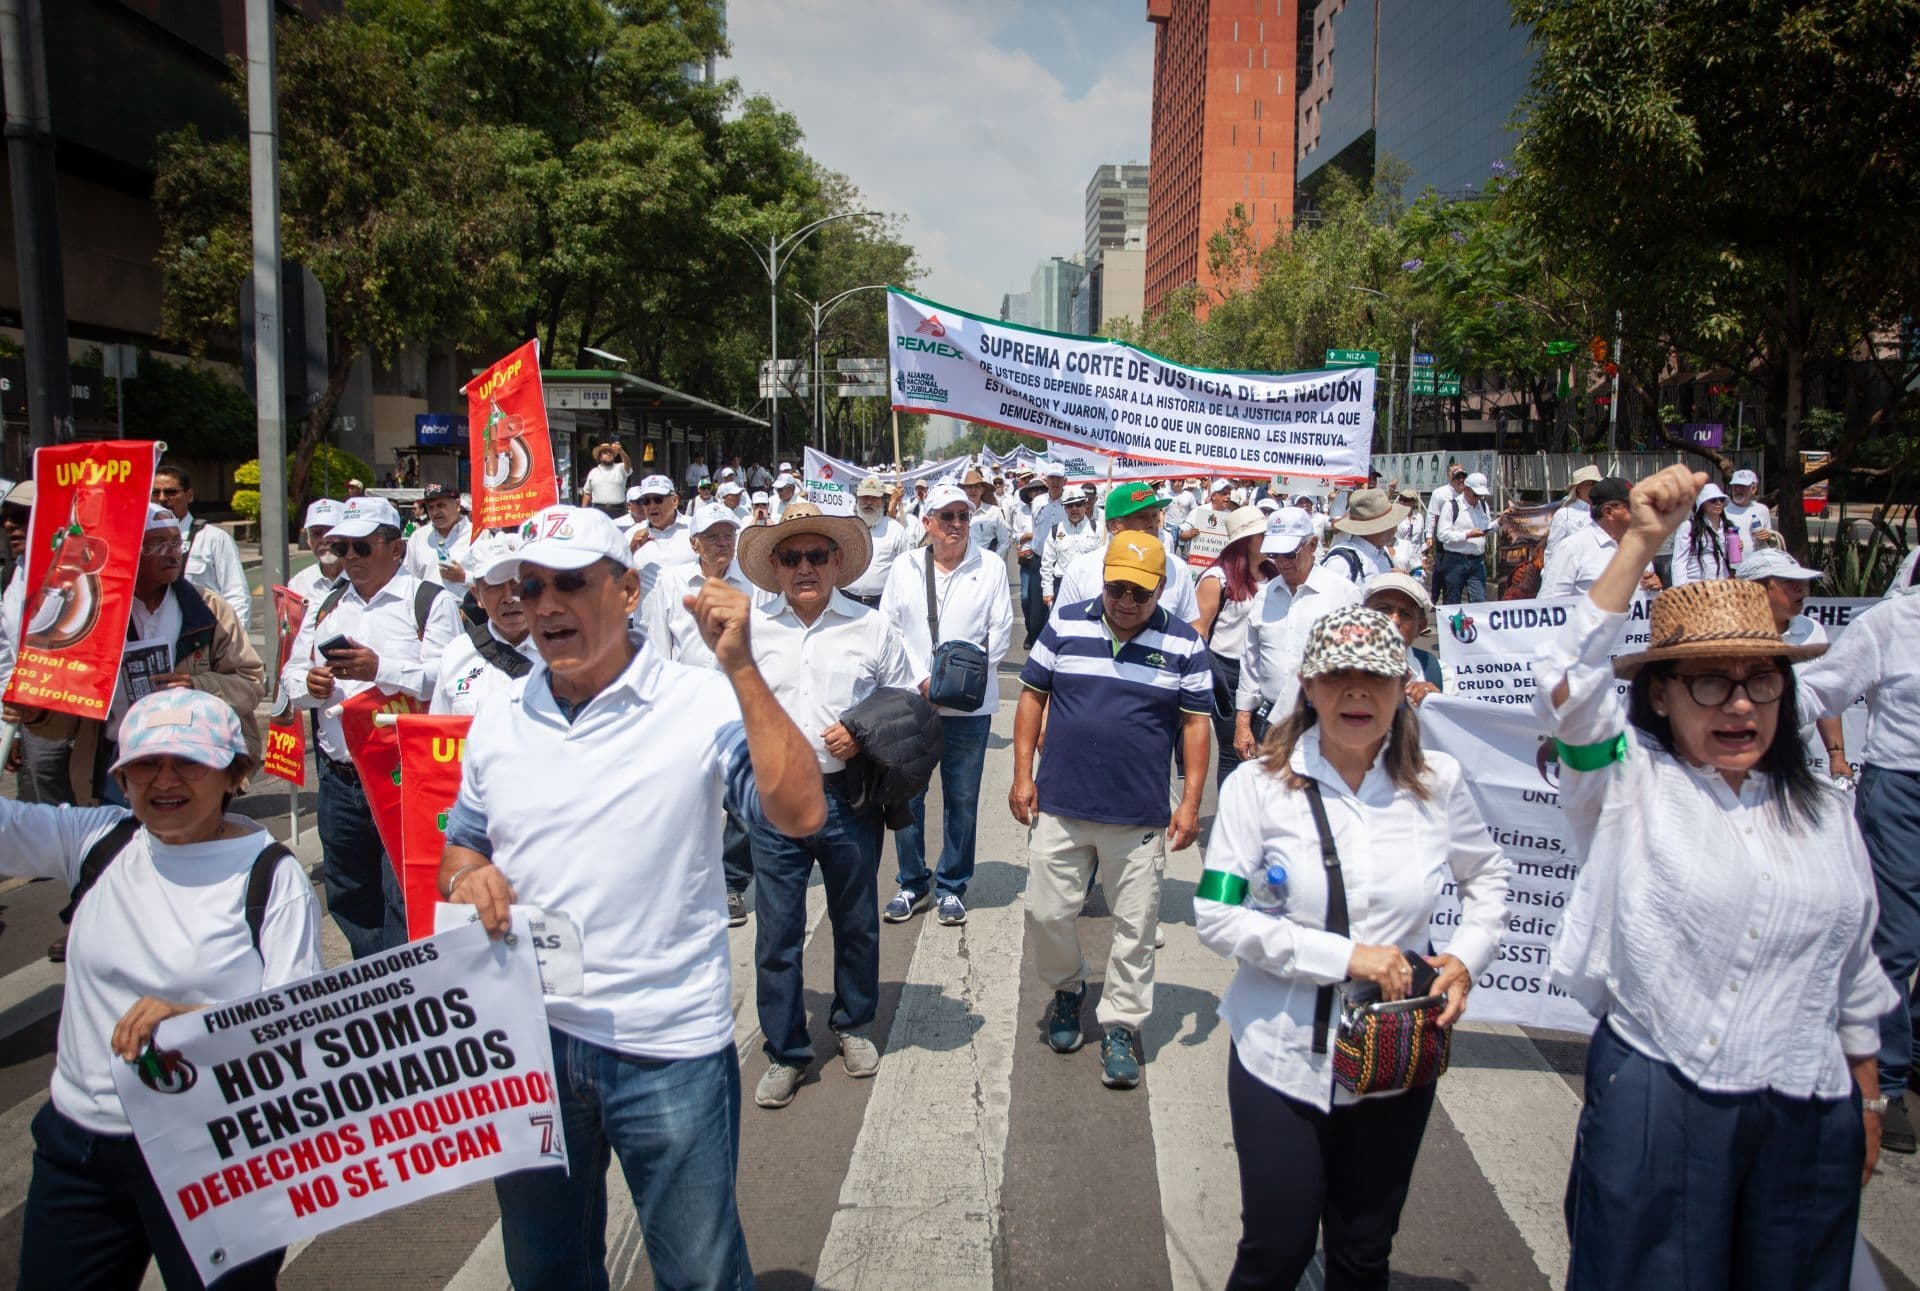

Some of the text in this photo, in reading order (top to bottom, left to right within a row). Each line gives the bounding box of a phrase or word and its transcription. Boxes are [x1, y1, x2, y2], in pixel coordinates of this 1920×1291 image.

[896, 335, 964, 360] PEMEX
[907, 371, 935, 381] ALIANZA
[979, 334, 1060, 369] SUPREMA
[1065, 351, 1124, 378] CORTE
[1127, 359, 1150, 383] DE
[1153, 365, 1232, 399] JUSTICIA
[1294, 375, 1362, 403] NACIÓN
[910, 385, 949, 397] JUBILADOS
[980, 360, 1360, 426] DE USTEDES DEPENDE PASAR A LA HISTORIA DE LA JUSTICIA POR LA QUE
[420, 424, 450, 435] telcel
[1000, 402, 1071, 431] DEMUESTREN
[1073, 424, 1088, 436] SU
[1090, 427, 1152, 449] AUTONOMÍA
[1154, 438, 1176, 453] QUE
[1178, 441, 1192, 455] EL
[1195, 443, 1237, 459] PUEBLO
[1240, 447, 1260, 462] LES
[1052, 399, 1061, 412] Y
[1062, 402, 1108, 423] JUARON,
[1111, 408, 1119, 421] O
[1121, 410, 1142, 427] POR
[1144, 413, 1159, 429] LO
[1161, 418, 1183, 433] QUE
[1186, 420, 1201, 435] UN
[1204, 423, 1260, 441] GOBIERNO
[1266, 429, 1287, 444] LES
[1289, 431, 1348, 447] INSTRUYA.
[1693, 429, 1712, 441] nu
[805, 480, 843, 492] PEMEX
[1488, 606, 1567, 631] CIUDAD
[39, 672, 53, 684] y
[66, 659, 89, 672] de
[1456, 664, 1472, 675] LA
[1476, 662, 1522, 674] SONDA
[17, 681, 105, 709] Petroleros
[1457, 679, 1504, 691] CRUDO
[202, 941, 440, 1034] FUIMOS TRABAJADORES
[250, 976, 417, 1045] ESPECIALIZADOS
[212, 986, 478, 1105] HOY SOMOS
[206, 1029, 517, 1160] PENSIONADOS
[176, 1123, 366, 1222] DERECHOS
[287, 1121, 502, 1219] NO SE TOCAN
